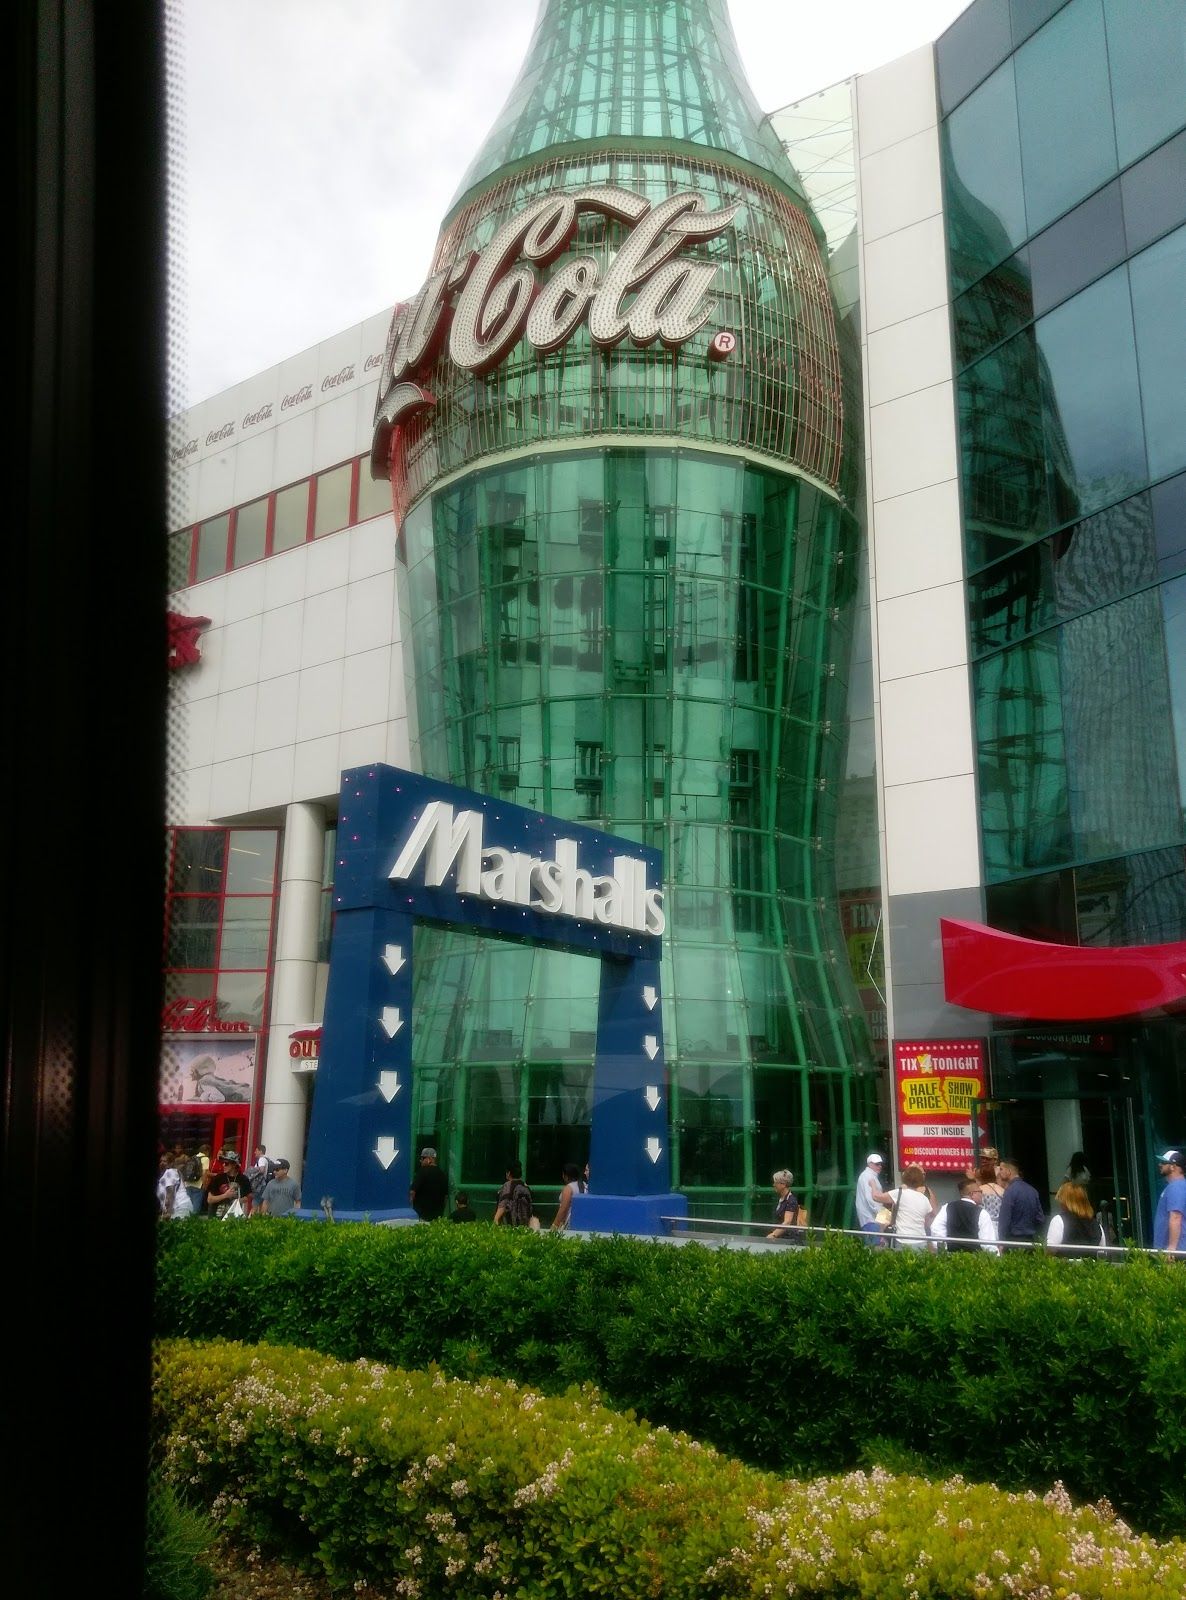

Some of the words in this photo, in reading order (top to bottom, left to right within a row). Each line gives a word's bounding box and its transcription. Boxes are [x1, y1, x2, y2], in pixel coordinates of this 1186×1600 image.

[388, 800, 666, 936] Marshalls
[290, 1040, 320, 1058] OUT
[304, 1061, 318, 1069] STE
[910, 1083, 938, 1096] HALF
[948, 1082, 973, 1095] SHOW
[908, 1096, 942, 1109] PRICE
[949, 1096, 971, 1109] TICKET
[923, 1127, 939, 1136] JUST
[941, 1127, 965, 1136] INSIDE
[914, 1147, 938, 1156] DISCOUNT
[938, 1147, 960, 1156] DINNERS
